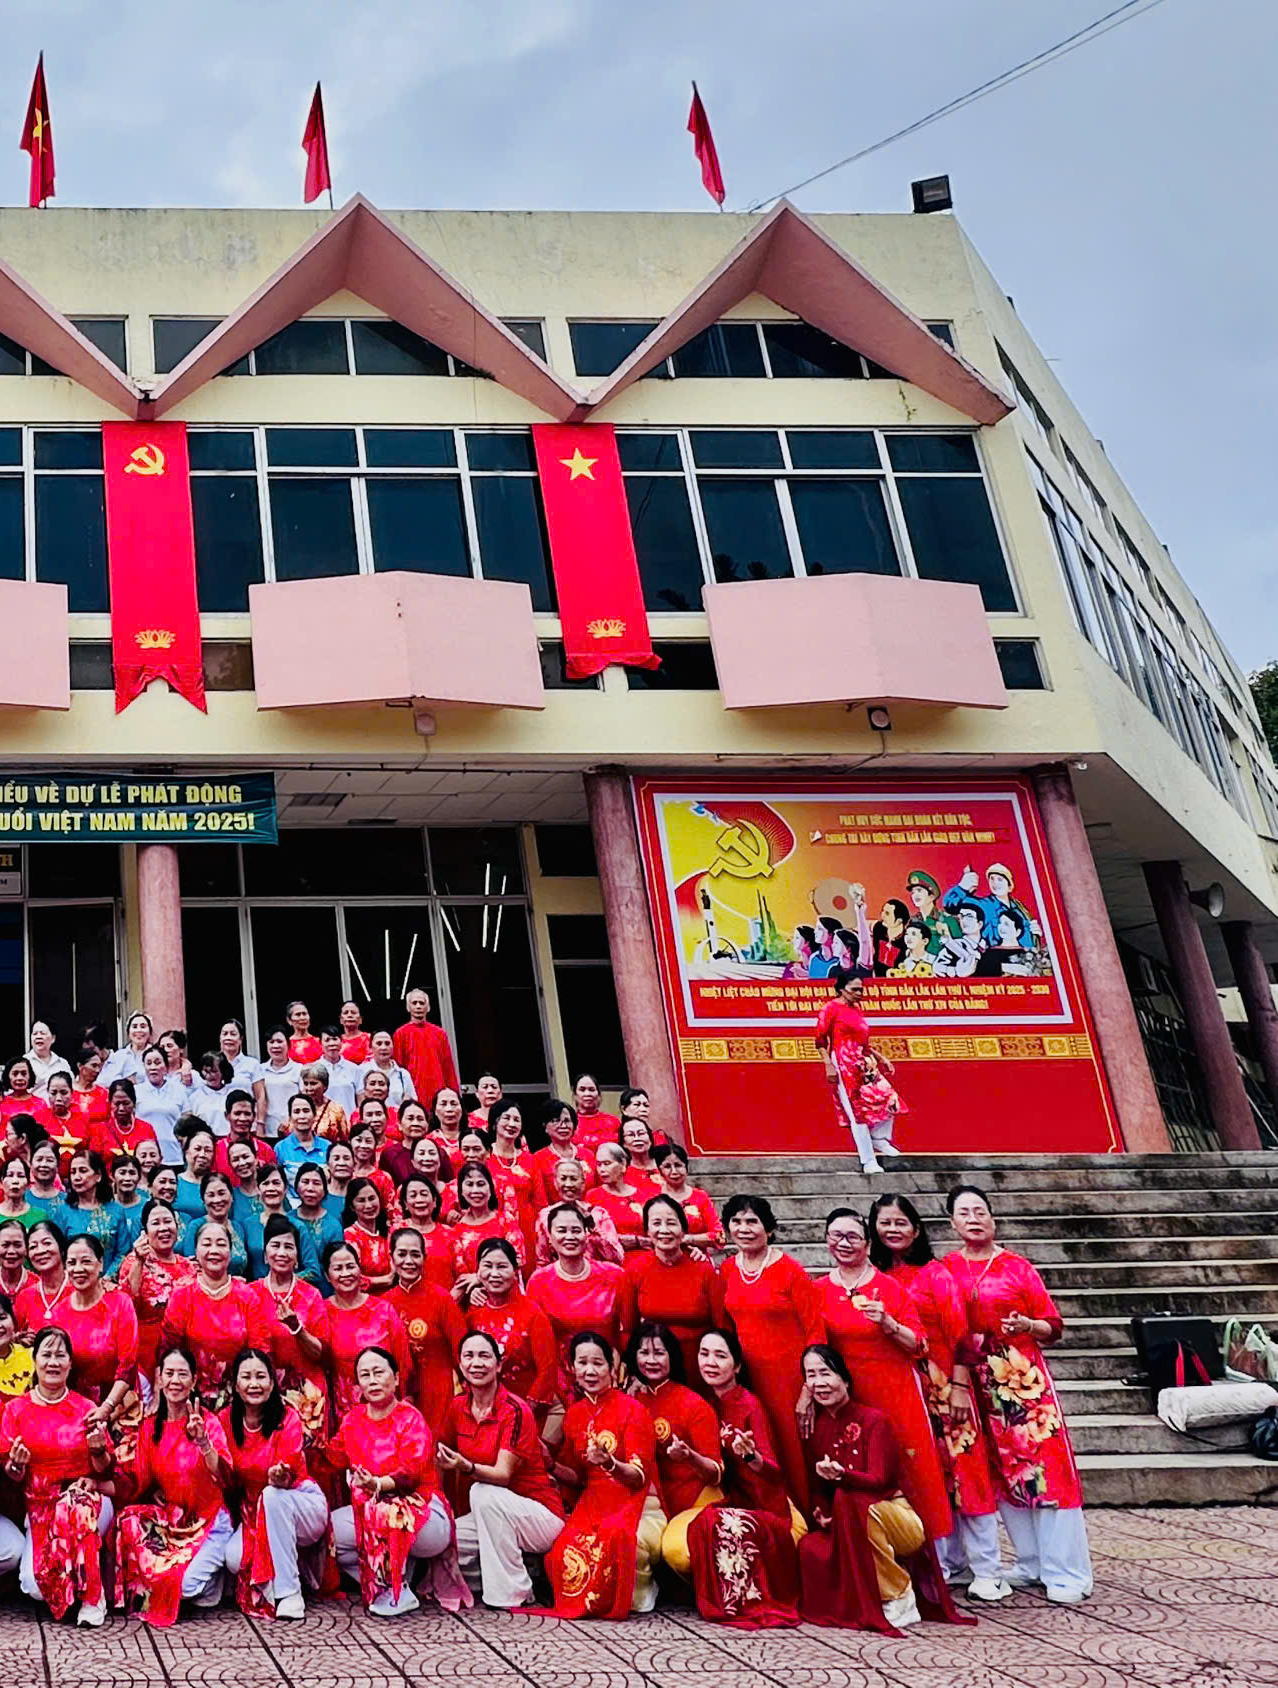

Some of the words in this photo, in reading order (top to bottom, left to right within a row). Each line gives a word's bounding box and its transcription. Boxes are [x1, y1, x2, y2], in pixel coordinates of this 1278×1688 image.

[35, 780, 59, 803] VỀ
[66, 784, 96, 806] DỰ
[101, 781, 121, 804] LỄ
[128, 783, 179, 804] PHÁT
[186, 783, 242, 806] ĐỘNG
[38, 810, 83, 834] VIỆT
[90, 812, 135, 831] NAM
[142, 810, 188, 831] NĂM
[193, 812, 255, 831] 2025!
